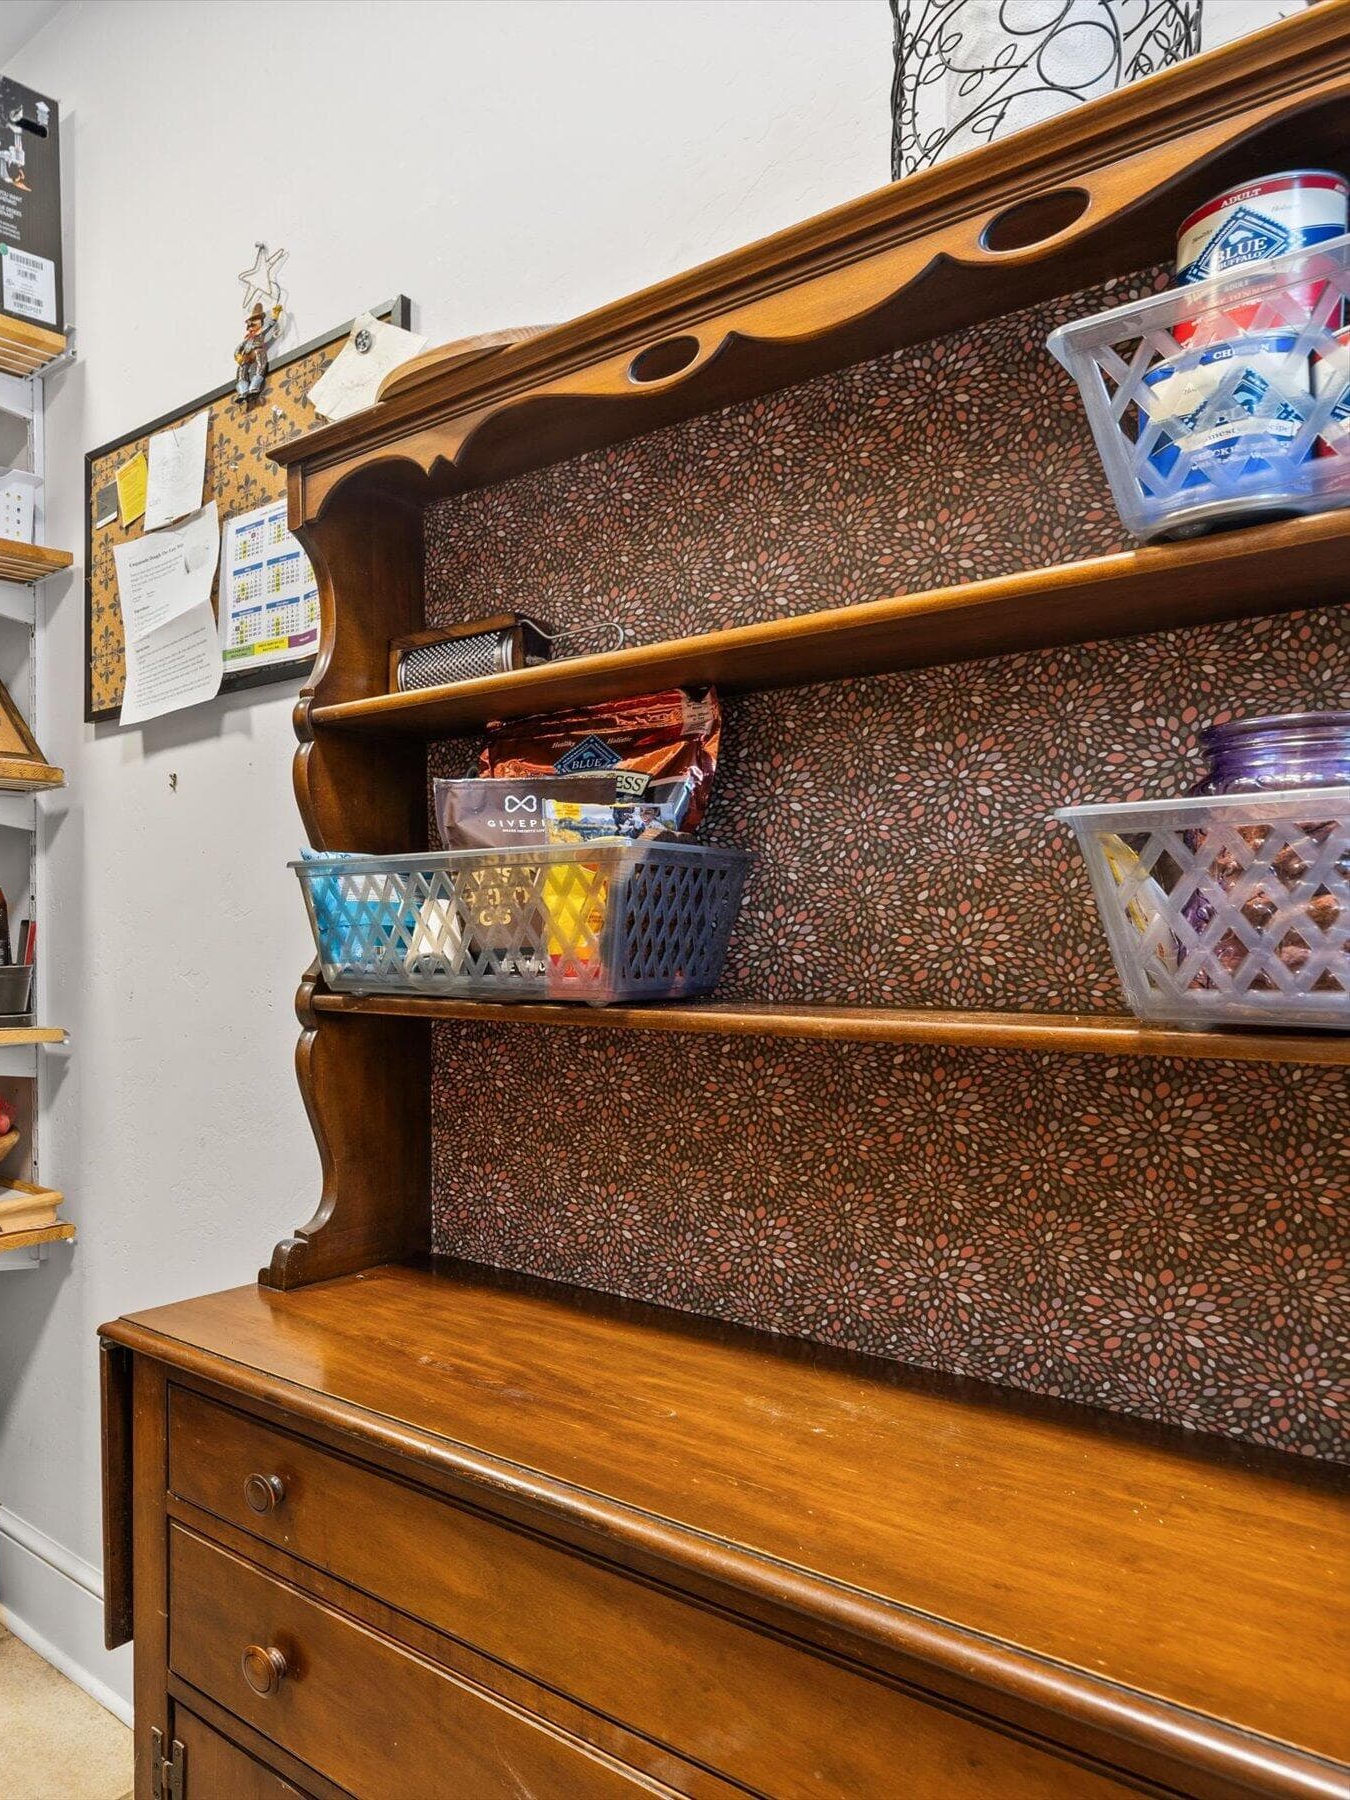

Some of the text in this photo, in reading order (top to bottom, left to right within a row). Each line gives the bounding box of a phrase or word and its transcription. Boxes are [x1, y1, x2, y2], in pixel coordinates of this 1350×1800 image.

[1221, 187, 1262, 208] ADULT
[1216, 237, 1268, 263] BLUE
[1219, 251, 1264, 269] BUFFALO
[552, 736, 634, 749] Healthy Holistic
[572, 757, 602, 770] BLUE
